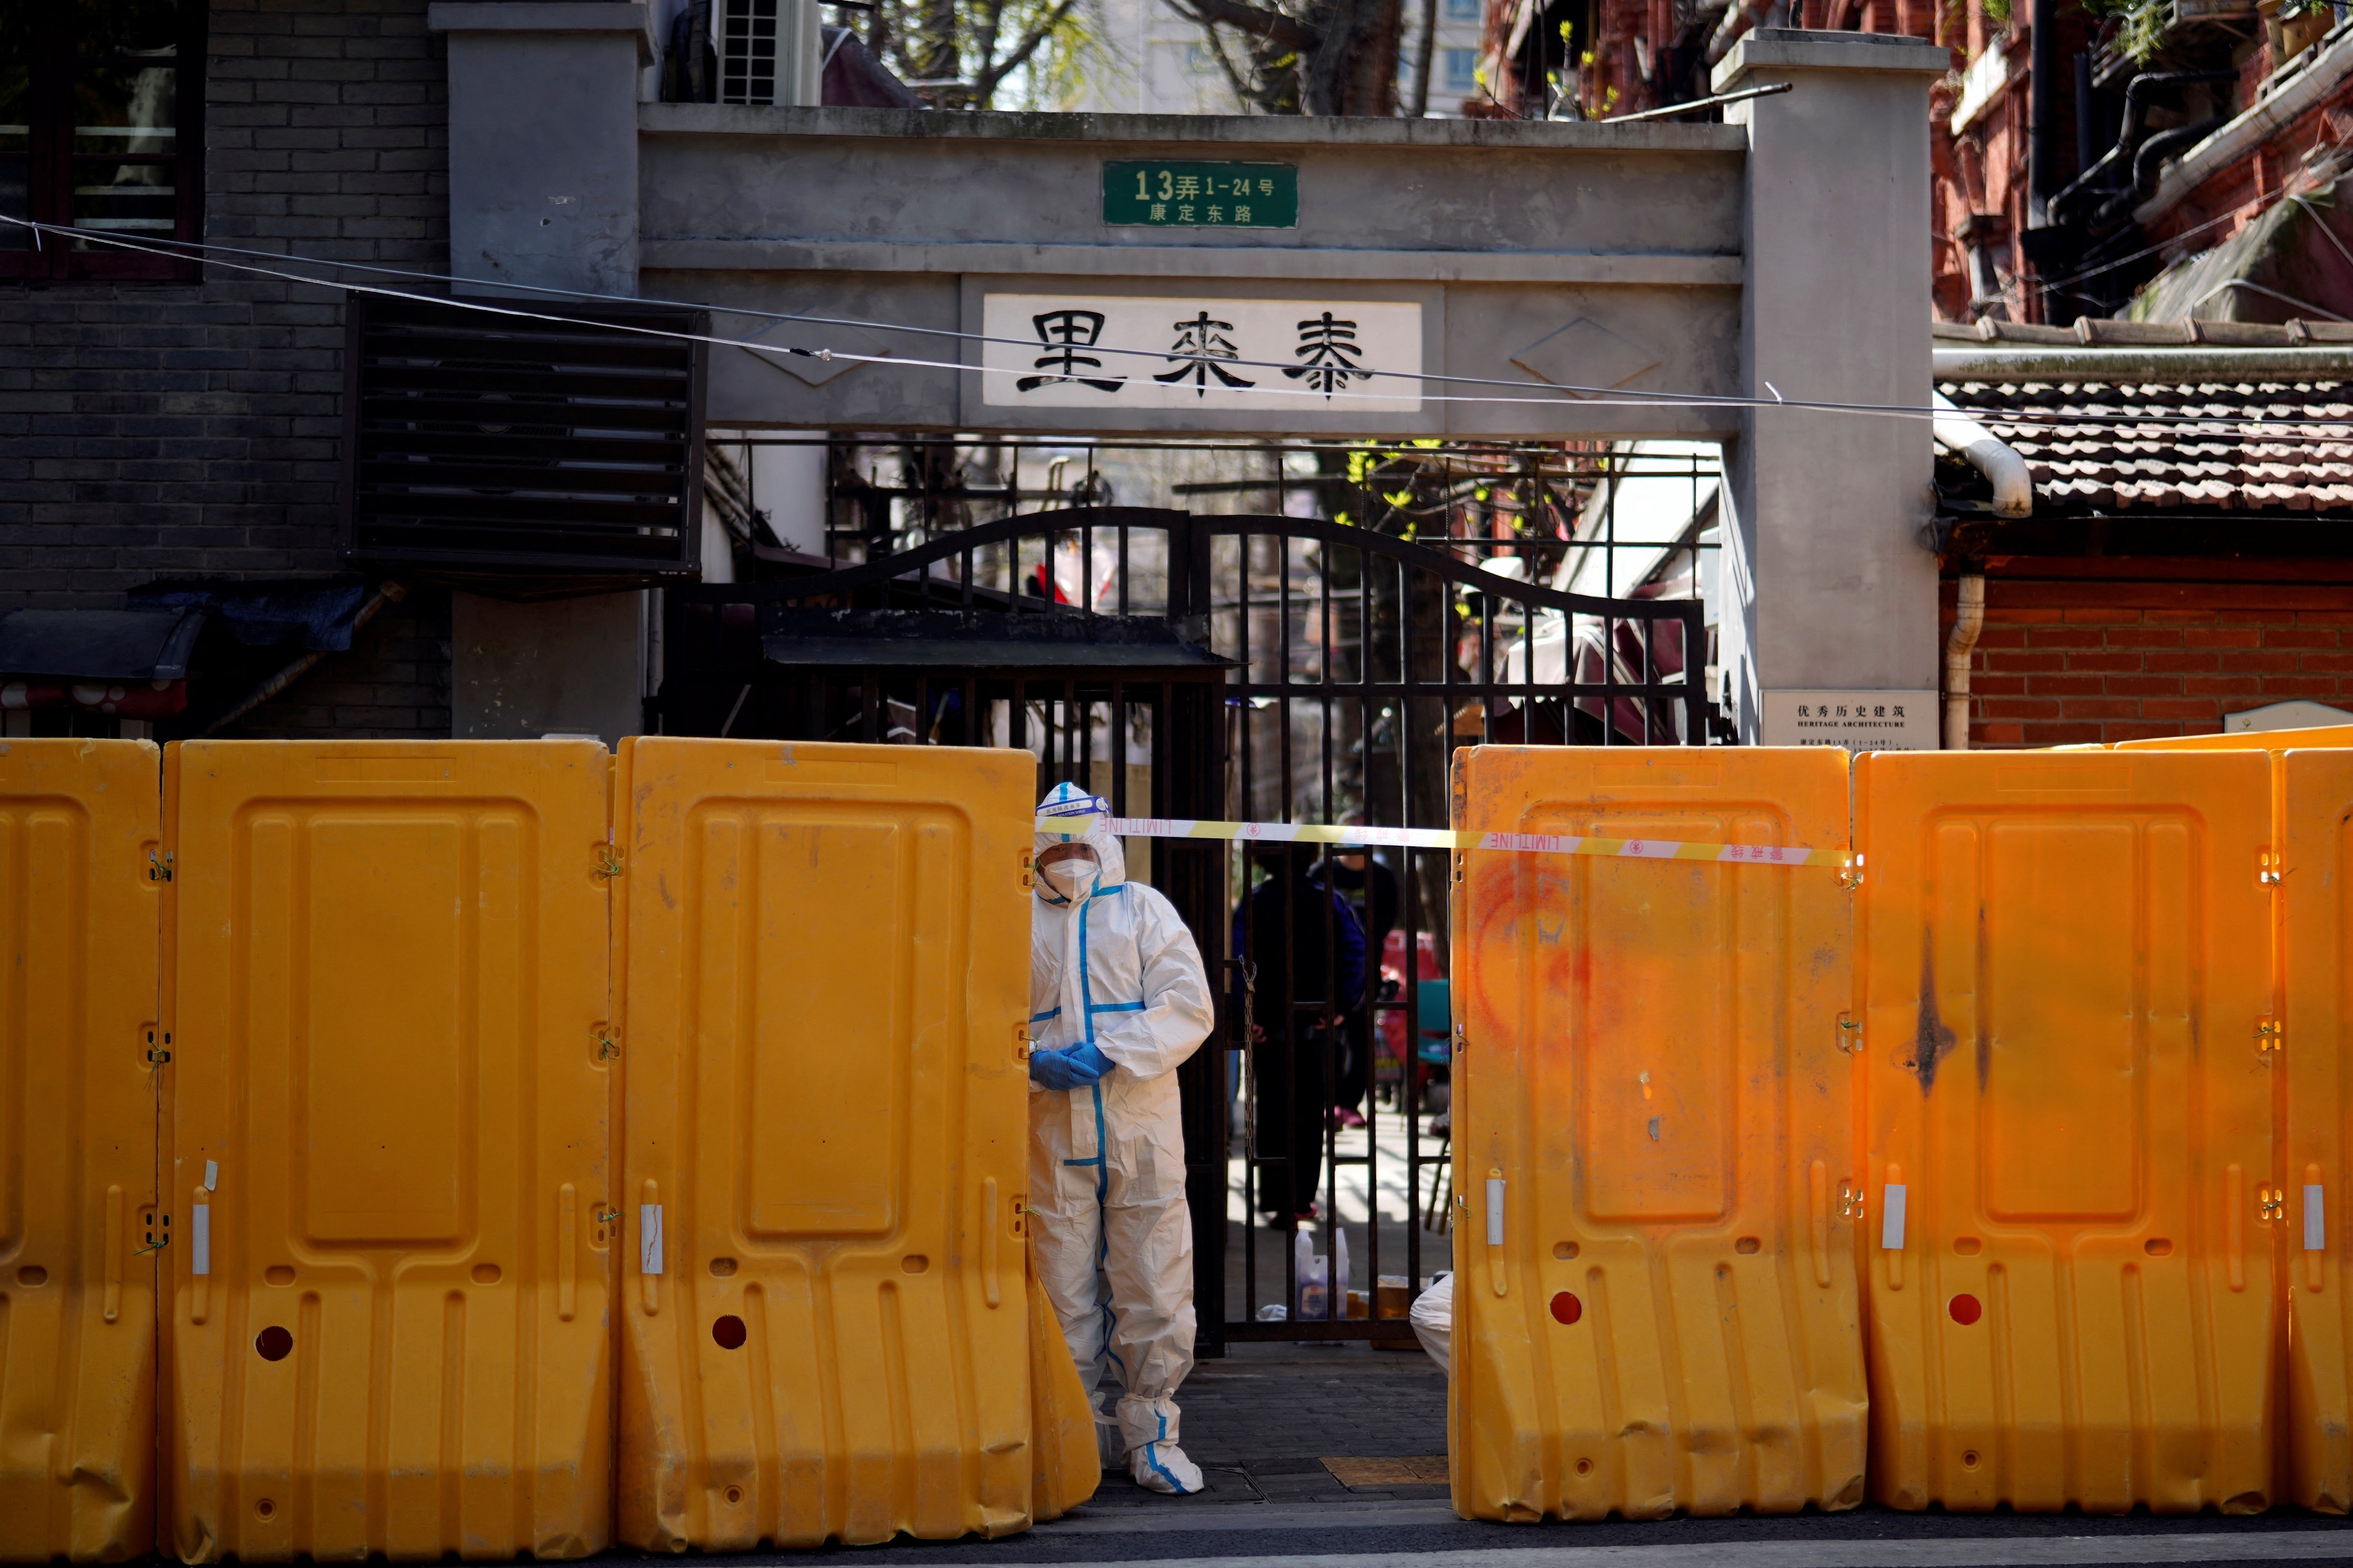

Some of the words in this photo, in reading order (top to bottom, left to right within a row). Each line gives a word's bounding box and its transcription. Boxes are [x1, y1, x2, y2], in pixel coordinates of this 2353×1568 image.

[1149, 203, 1252, 223] 康定东路
[1798, 705, 1905, 718] 优秀历史建筑
[1353, 827, 1411, 844] 警戒线
[1730, 844, 1783, 860] 警戒线
